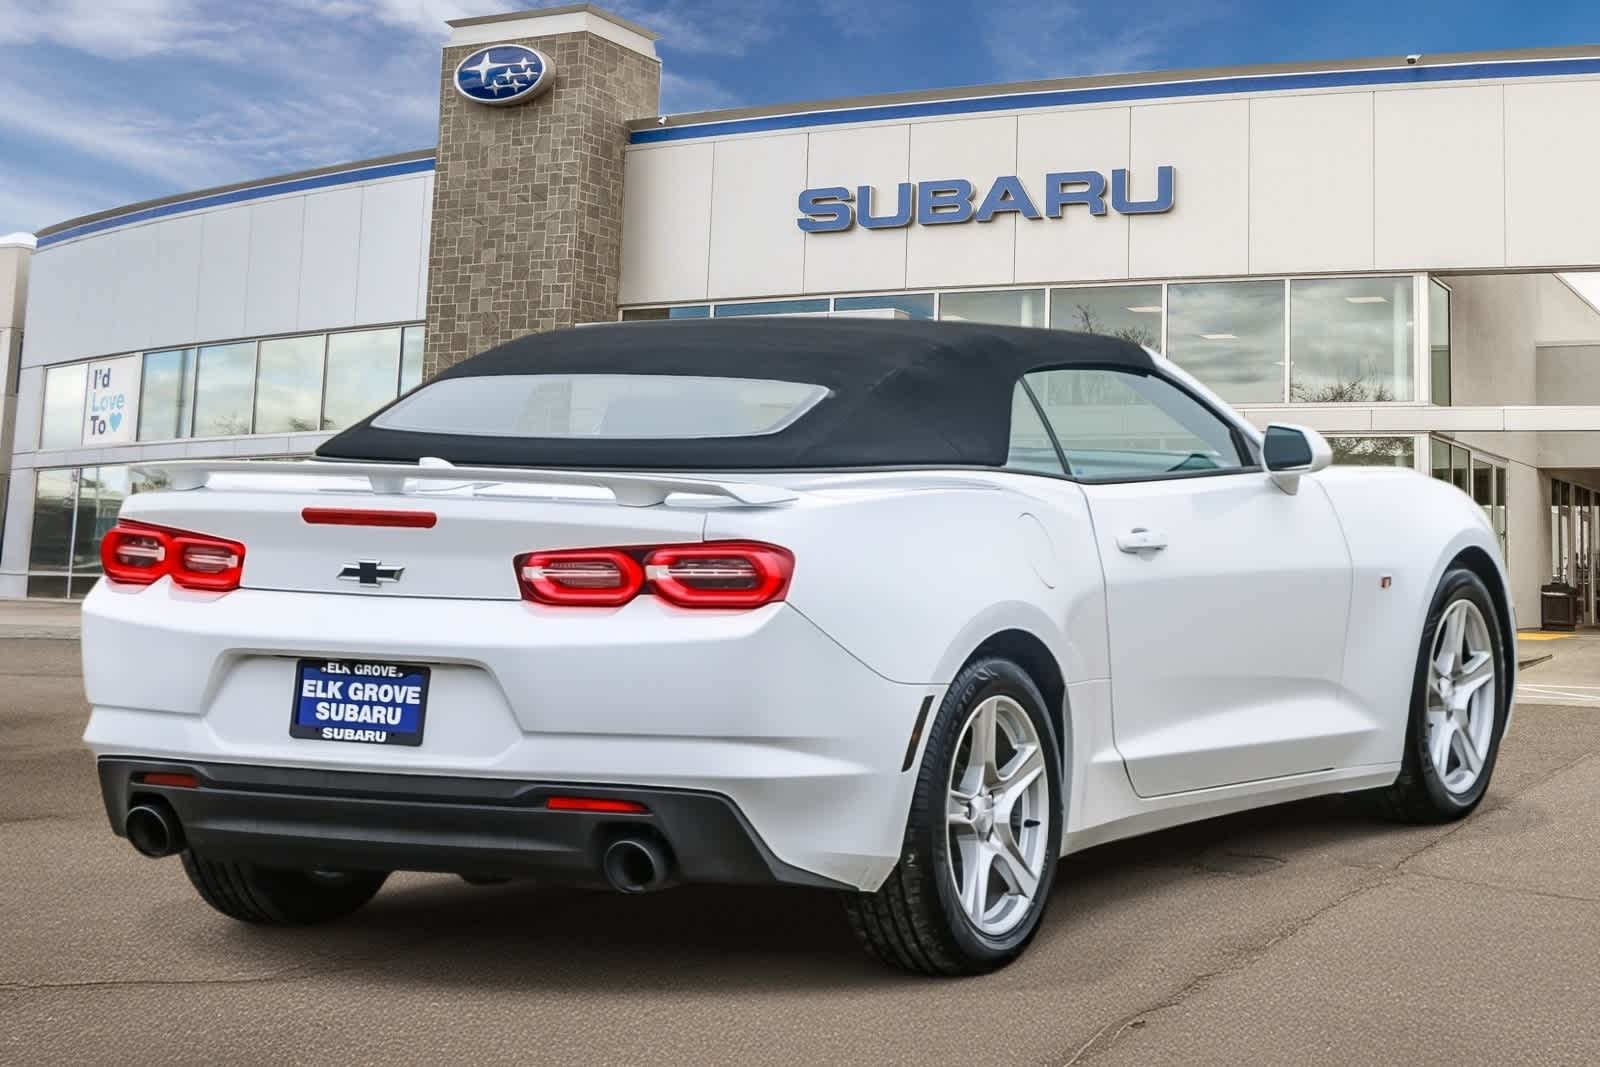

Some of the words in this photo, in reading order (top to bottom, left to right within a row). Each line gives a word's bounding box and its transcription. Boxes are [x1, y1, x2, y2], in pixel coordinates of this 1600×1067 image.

[796, 165, 1175, 233] SUBARU
[94, 368, 110, 389] I'd
[92, 392, 124, 411] Love
[91, 416, 106, 435] To
[355, 664, 396, 676] GROVE
[302, 679, 342, 699] ELK
[348, 683, 421, 704] GROVE
[315, 702, 401, 725] SUBARU
[322, 727, 386, 742] SUBARU
